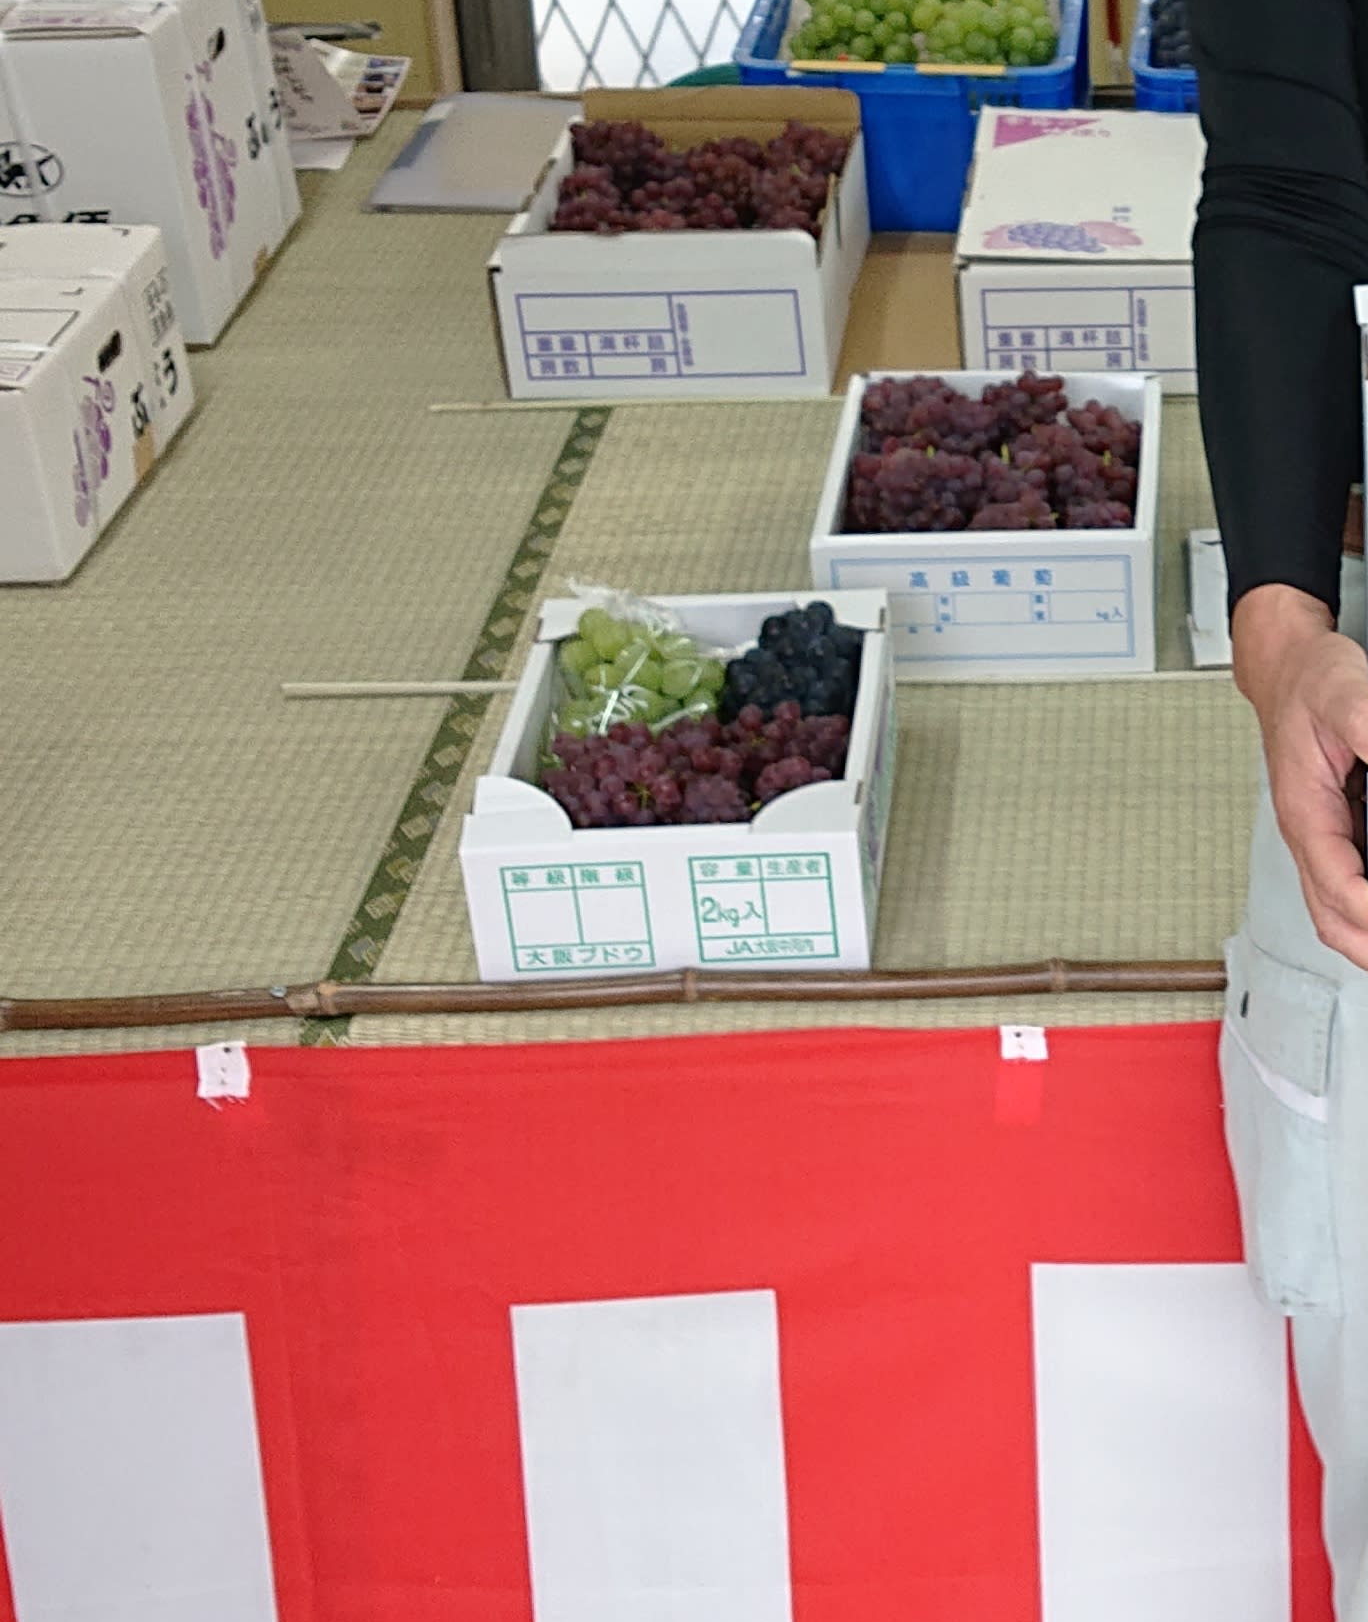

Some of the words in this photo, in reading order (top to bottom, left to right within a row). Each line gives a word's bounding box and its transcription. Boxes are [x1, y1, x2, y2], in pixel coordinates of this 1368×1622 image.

[767, 858, 821, 876] 生産者
[700, 896, 763, 928] 2kg入
[526, 946, 644, 966] 大阪ブドウ
